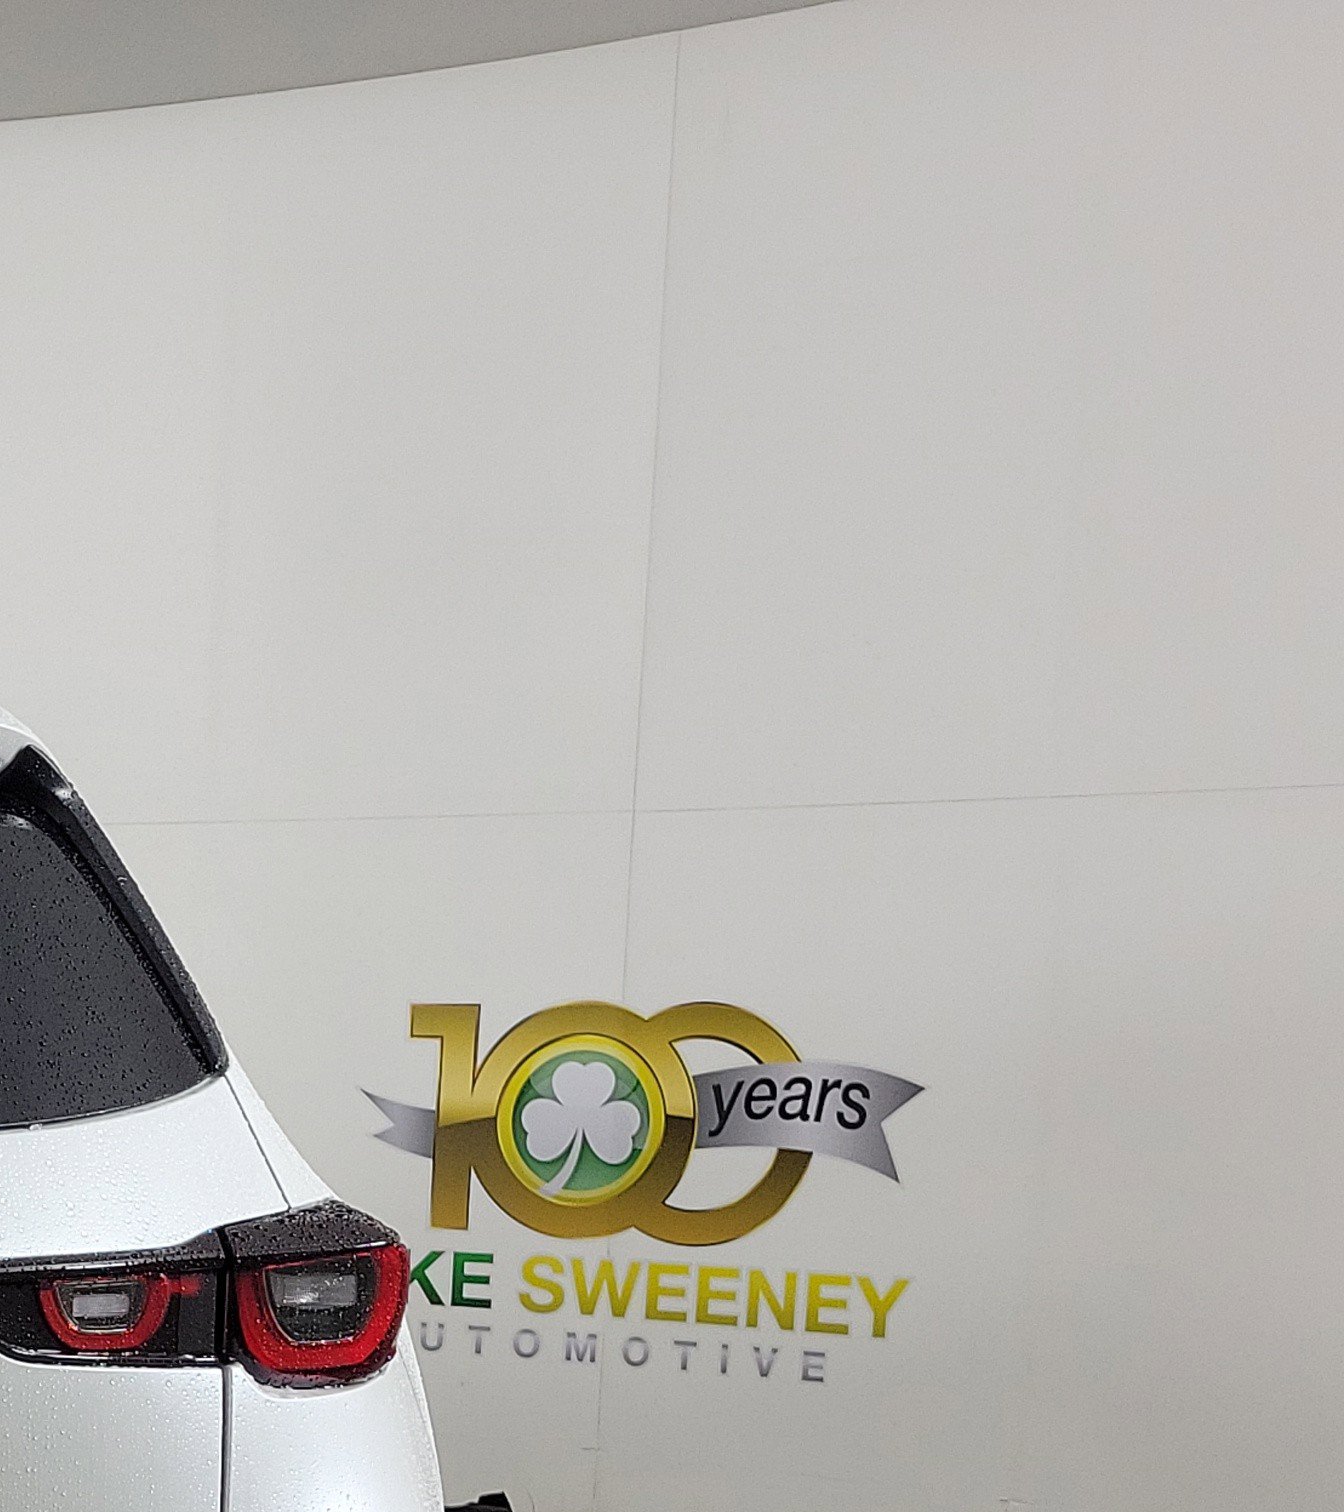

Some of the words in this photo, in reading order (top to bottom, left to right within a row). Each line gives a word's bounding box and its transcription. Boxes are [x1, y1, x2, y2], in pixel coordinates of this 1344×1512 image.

[409, 1001, 813, 1246] 100
[708, 1076, 871, 1136] years
[408, 1250, 494, 1310] KE
[517, 1254, 910, 1339] SWEENEY
[420, 1322, 826, 1383] UTOMOTIVE
